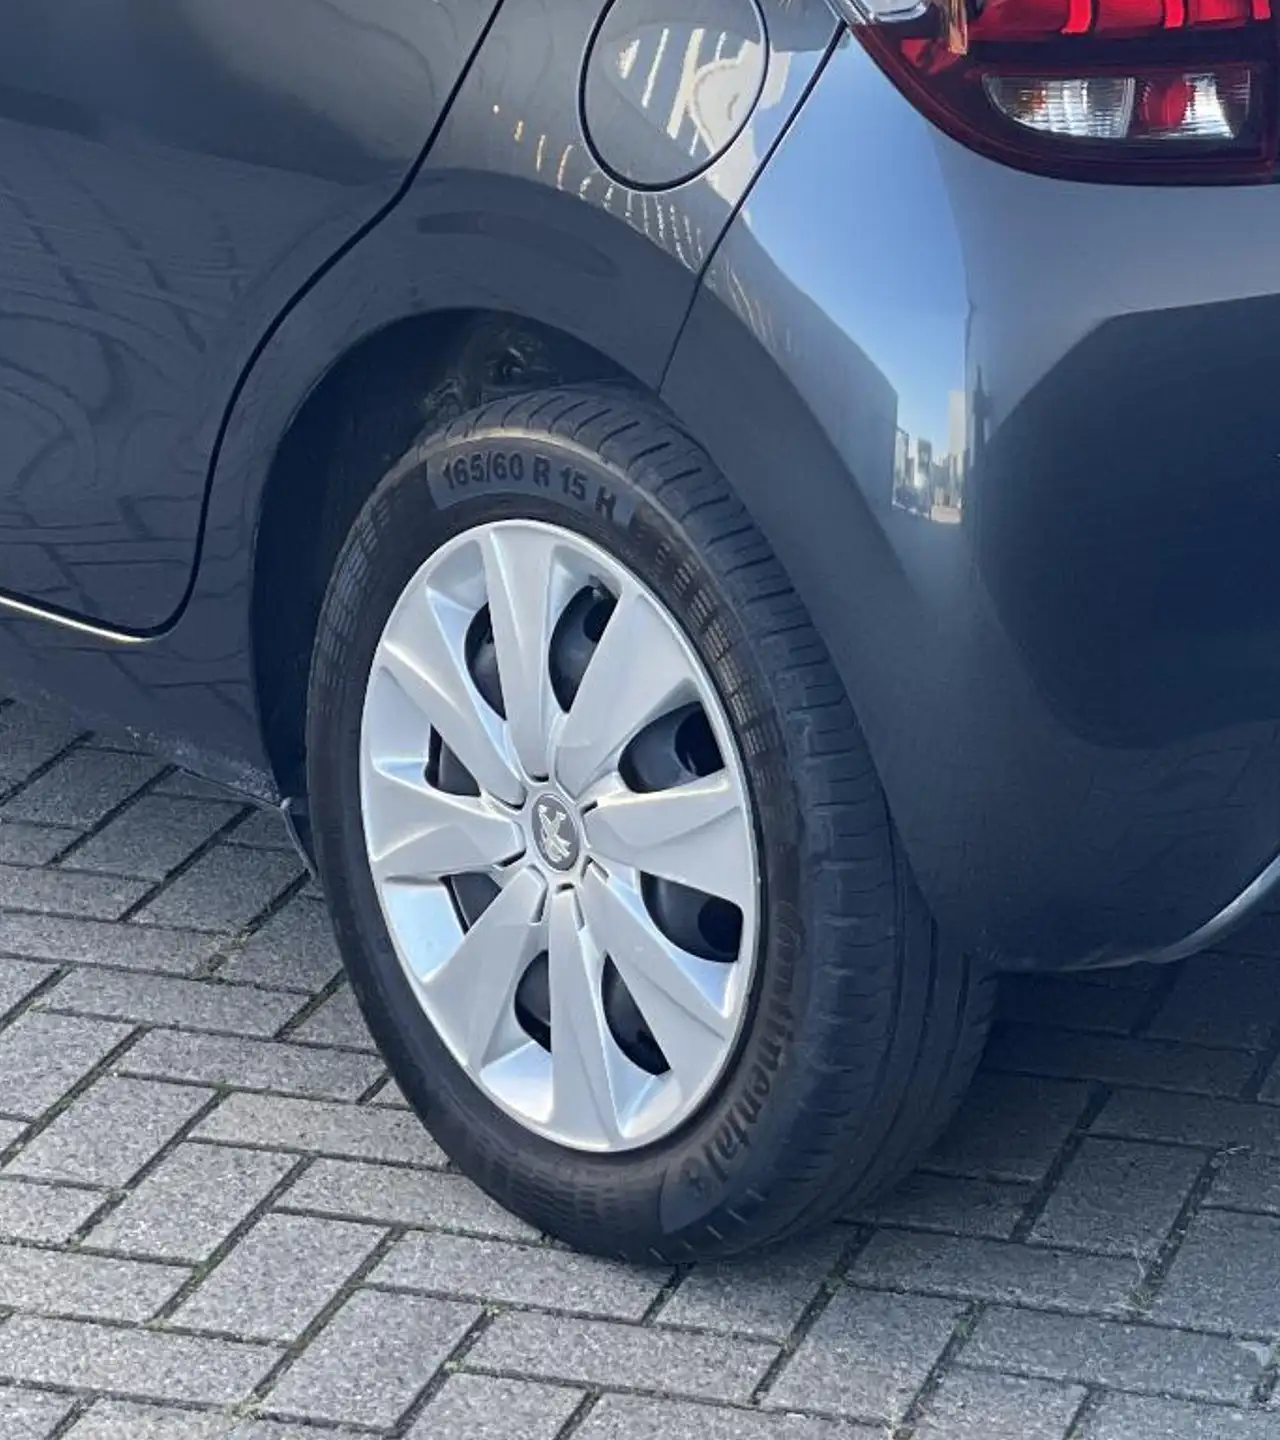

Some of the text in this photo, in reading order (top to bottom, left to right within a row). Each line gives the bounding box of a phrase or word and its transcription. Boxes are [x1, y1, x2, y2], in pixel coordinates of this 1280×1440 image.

[442, 450, 618, 520] 165/60 R 15 H
